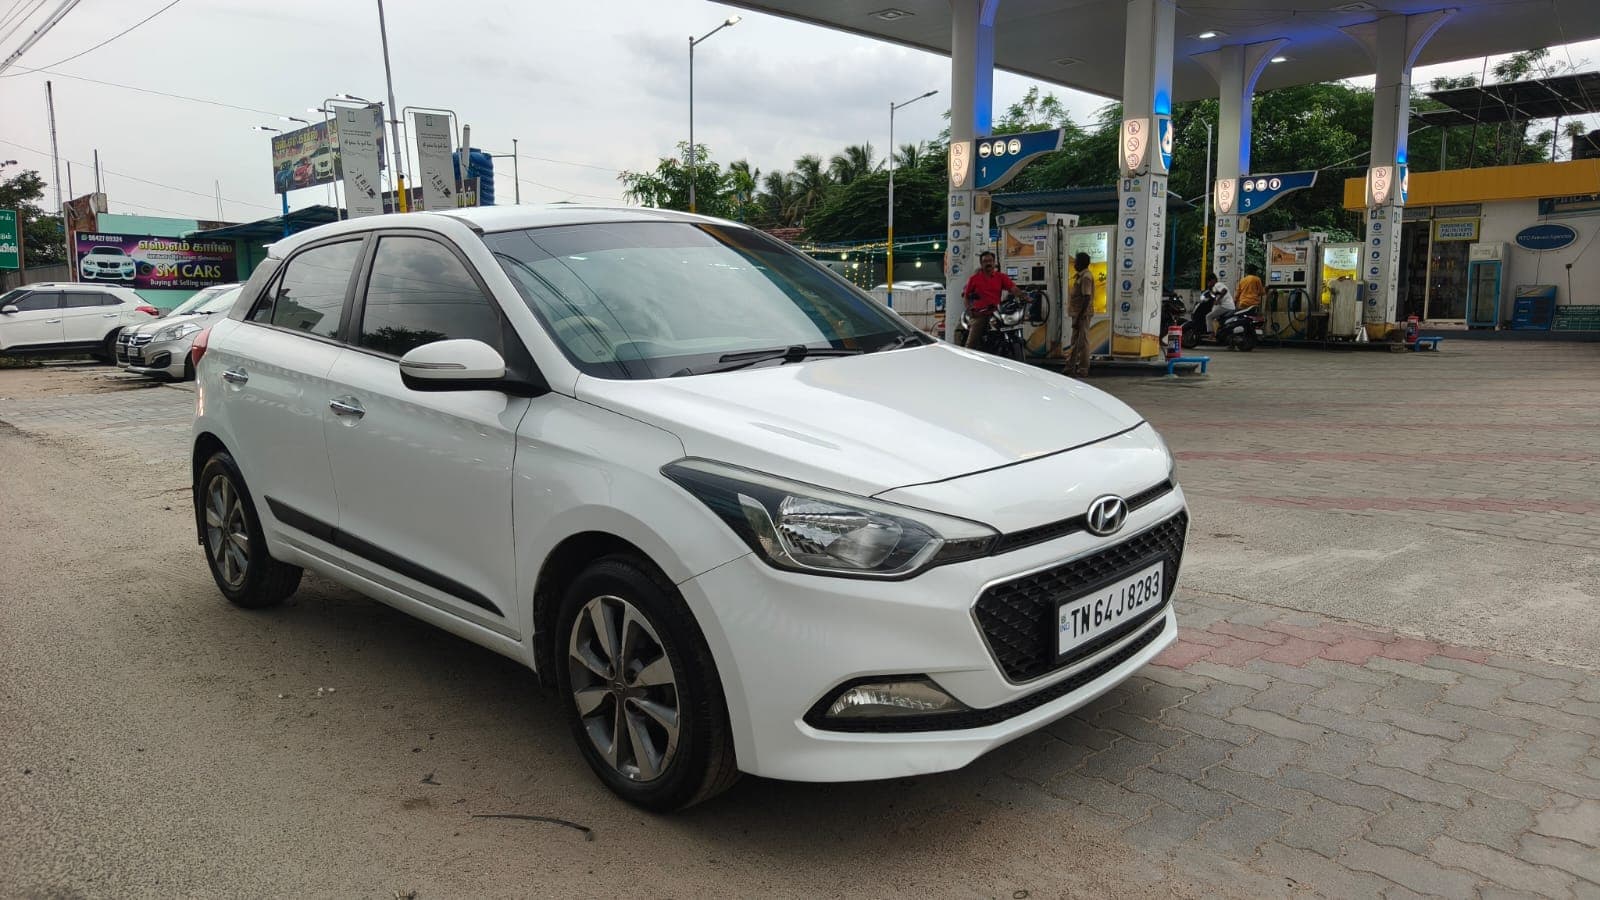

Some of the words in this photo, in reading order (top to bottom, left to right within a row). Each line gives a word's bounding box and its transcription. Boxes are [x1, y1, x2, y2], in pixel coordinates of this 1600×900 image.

[981, 166, 987, 178] 1
[1244, 198, 1251, 208] 3
[156, 264, 178, 277] SM
[182, 265, 222, 278] CARS
[150, 279, 171, 287] Buying
[1071, 603, 1091, 639] TN
[1094, 593, 1113, 627] 64
[1116, 587, 1125, 616] J
[1127, 570, 1160, 611] 8283
